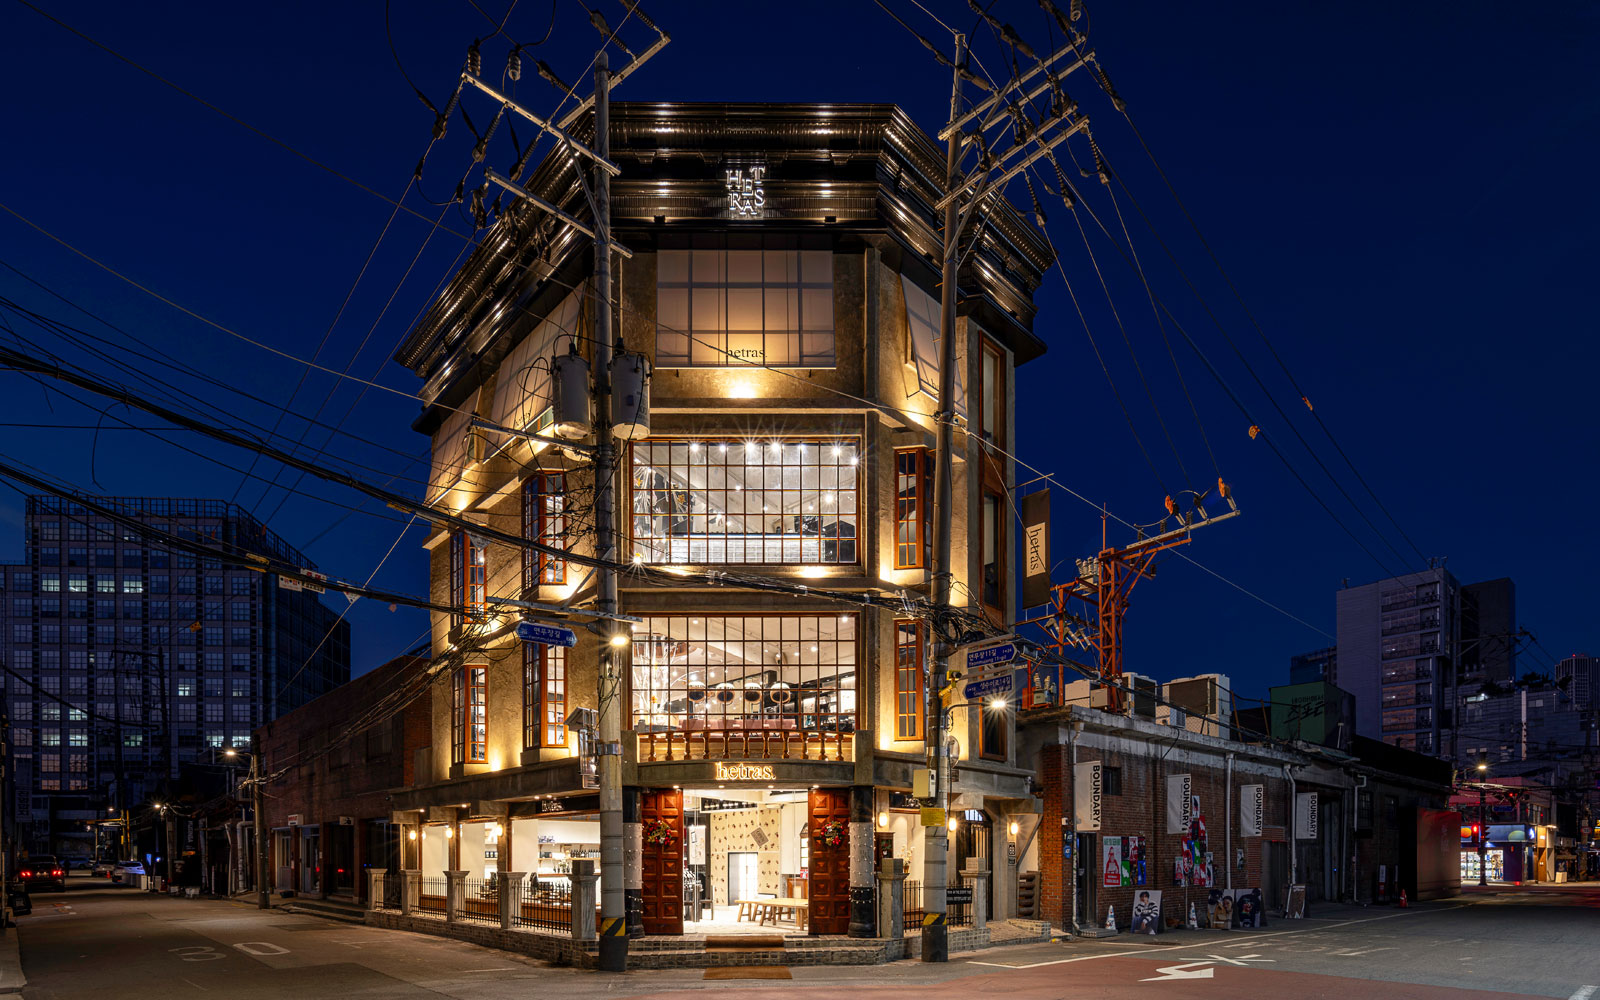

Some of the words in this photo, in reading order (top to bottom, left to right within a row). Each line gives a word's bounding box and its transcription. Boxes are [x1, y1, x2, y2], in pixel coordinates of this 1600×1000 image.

[715, 761, 776, 780] hetras.
[1092, 765, 1101, 823] BOUNDARY
[1182, 777, 1191, 827] BOUNDARY
[1255, 787, 1263, 830] BOUNDARY
[1309, 794, 1317, 833] BOUNDARY
